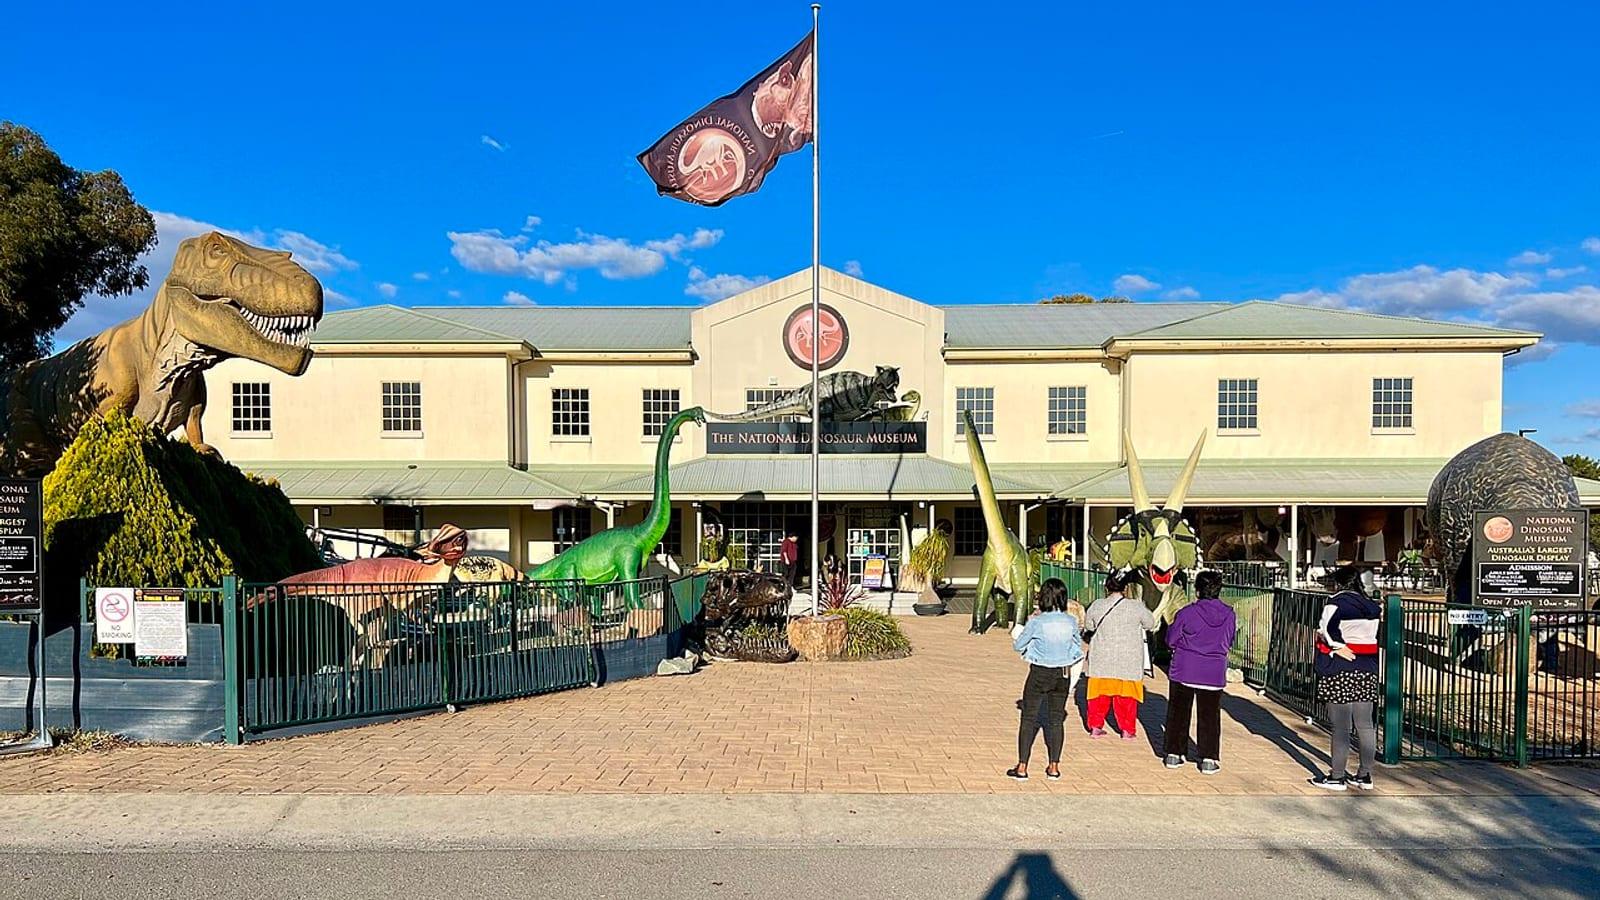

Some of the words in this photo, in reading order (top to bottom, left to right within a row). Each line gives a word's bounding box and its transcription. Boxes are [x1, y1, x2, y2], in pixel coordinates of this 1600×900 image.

[711, 432, 734, 444] THE
[738, 432, 798, 444] NATIONAL
[801, 432, 864, 444] DNOSAUR
[866, 432, 918, 444] MUSEUM
[1526, 516, 1577, 524] NATIONAL
[1520, 526, 1573, 534] DINOSAUR
[1524, 535, 1567, 543] MUSEUM
[1487, 546, 1536, 554] AUSTRALIA'S
[1537, 546, 1574, 554] LARGEST
[1491, 554, 1535, 562] DINOSAUR
[1536, 554, 1570, 562] DISPLAY
[1482, 598, 1503, 606] OPEN
[1505, 597, 1511, 606] 7
[1513, 599, 1533, 607] DAYS
